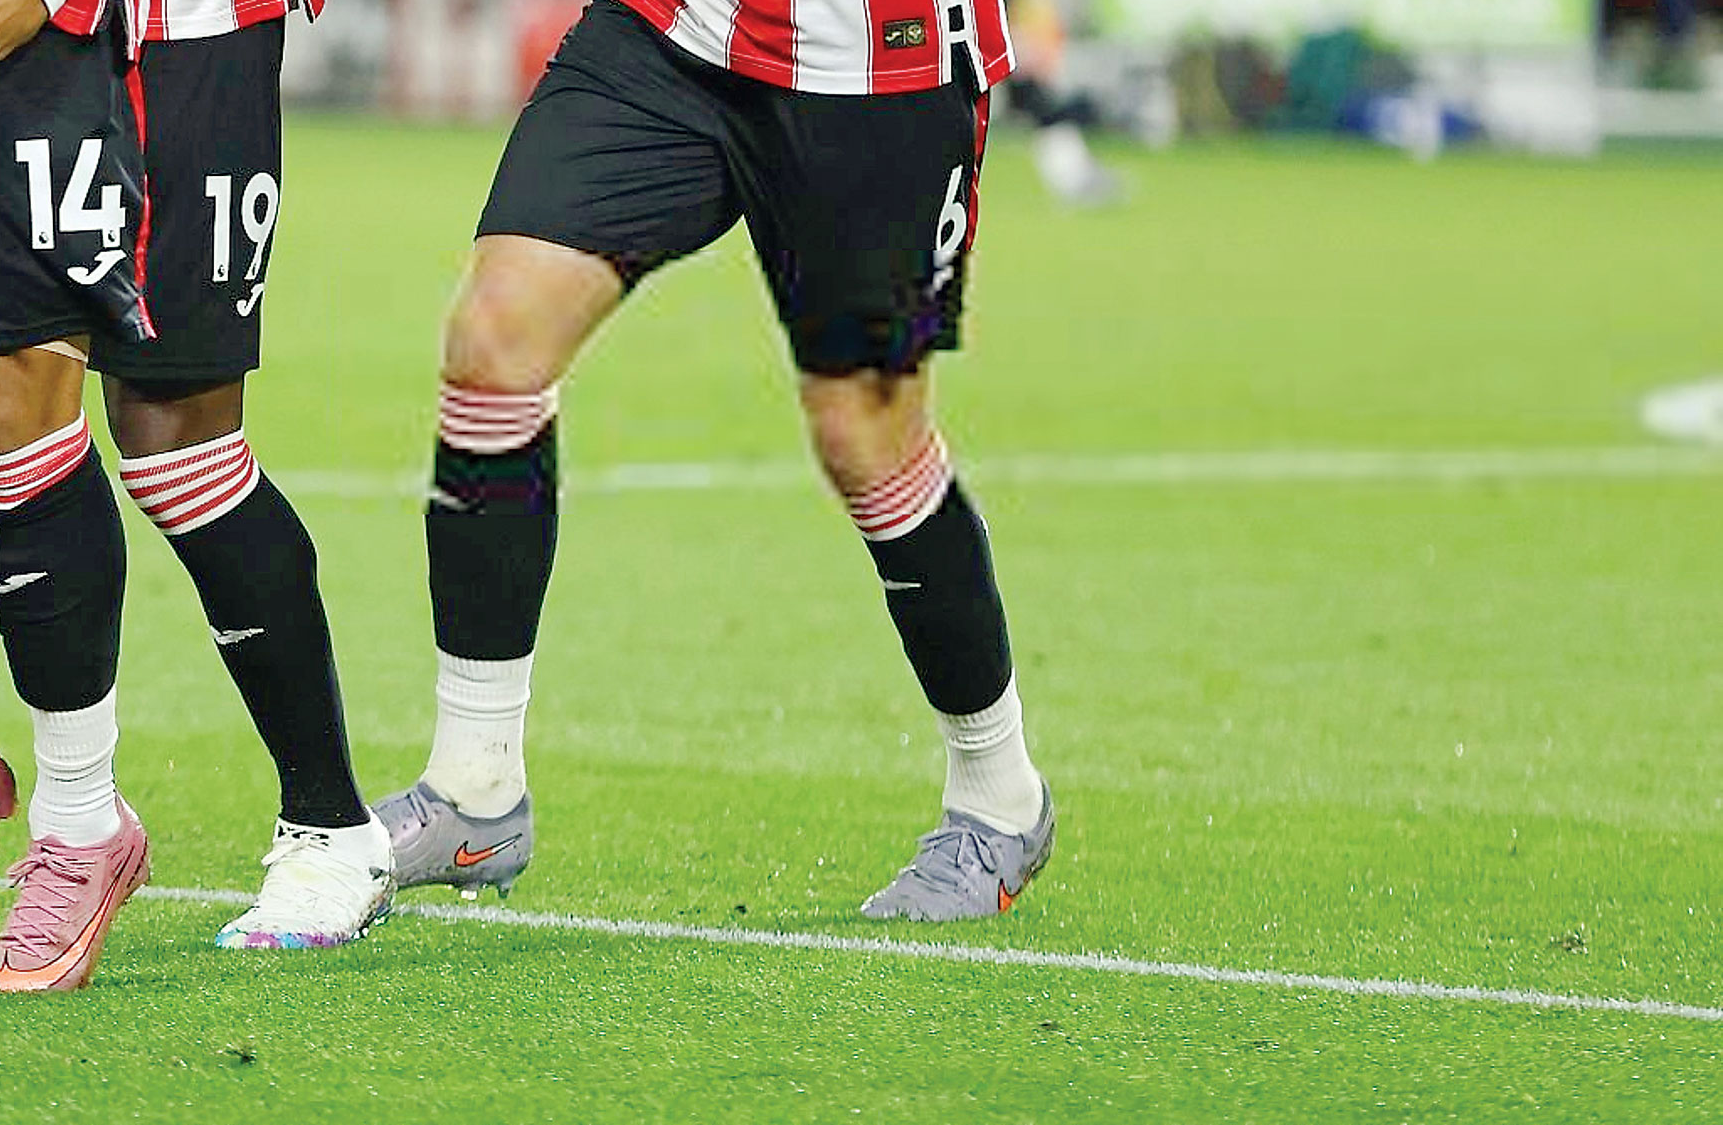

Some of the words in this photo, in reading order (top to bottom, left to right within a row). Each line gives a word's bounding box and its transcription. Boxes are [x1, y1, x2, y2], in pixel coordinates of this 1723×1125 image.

[14, 137, 127, 250] 14
[204, 171, 279, 282] 19
[933, 163, 968, 268] 6
